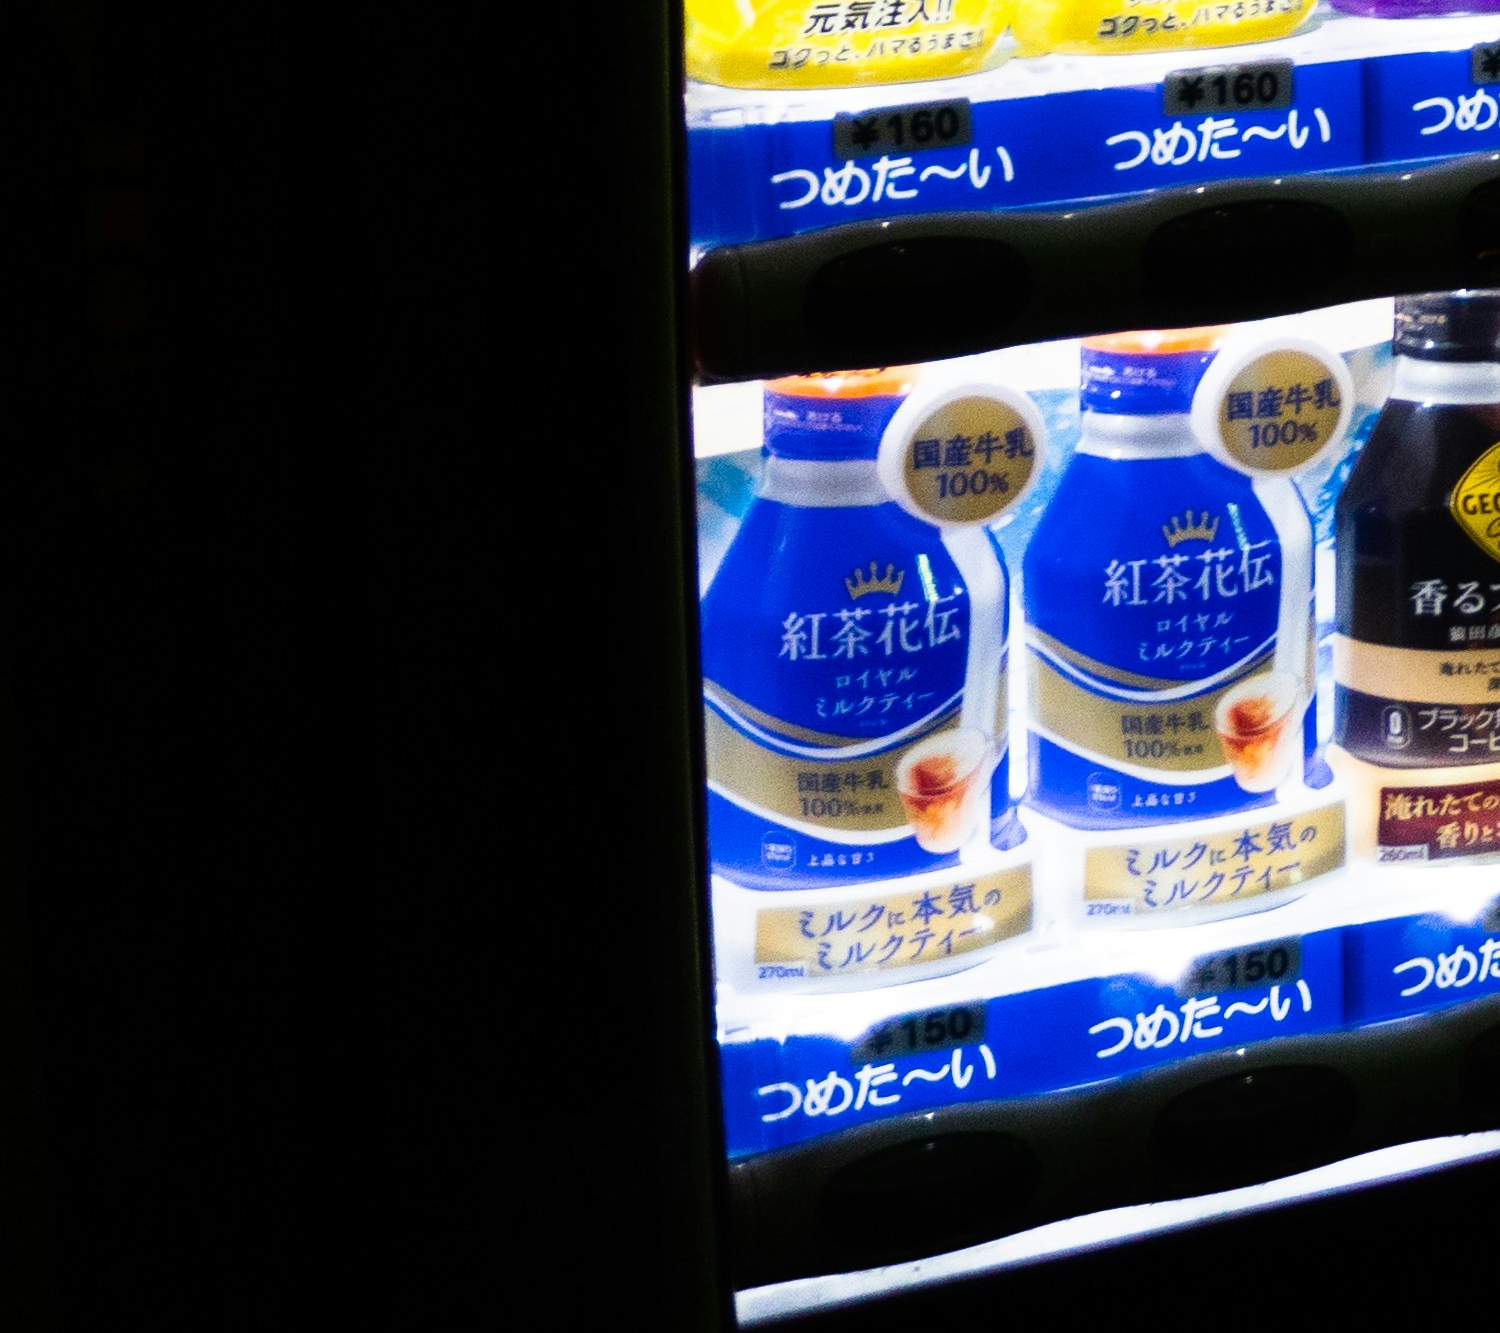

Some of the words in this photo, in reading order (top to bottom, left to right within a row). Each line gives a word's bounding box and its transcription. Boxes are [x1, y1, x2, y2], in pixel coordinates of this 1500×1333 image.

[1177, 71, 1278, 108] ¥160
[914, 427, 1034, 470] 国産牛乳
[936, 469, 1010, 499] 100%
[836, 665, 918, 688] ロイヤル
[816, 687, 934, 718] ミルクティー
[798, 885, 1000, 939] ミルクに本気の
